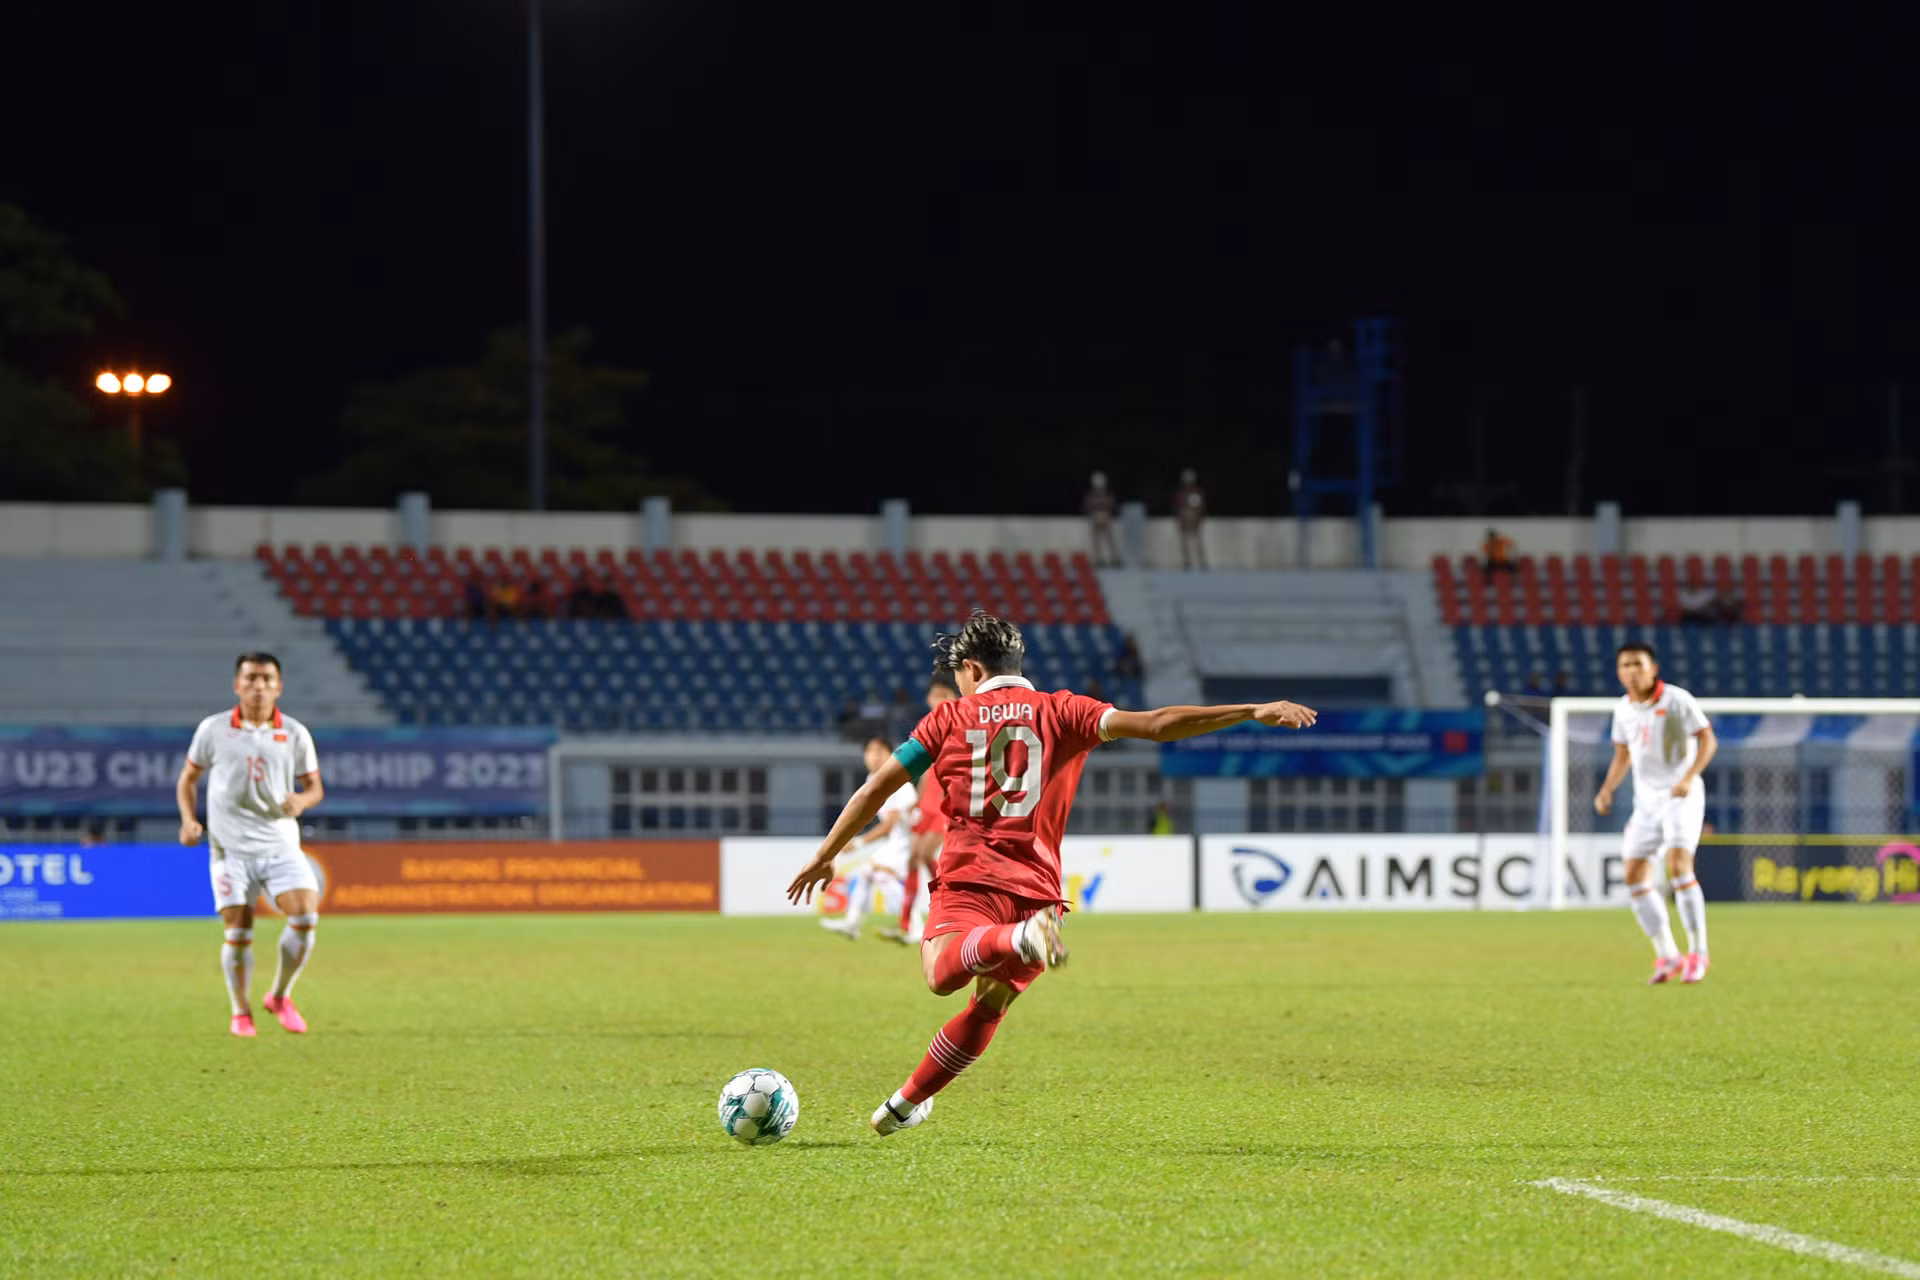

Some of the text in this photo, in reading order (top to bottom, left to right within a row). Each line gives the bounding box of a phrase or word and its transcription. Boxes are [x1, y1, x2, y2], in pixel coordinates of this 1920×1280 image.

[979, 703, 1033, 724] DEWA
[16, 751, 97, 788] U23
[247, 756, 266, 783] 15
[966, 726, 1042, 817] 19
[1753, 857, 1880, 902] Rayong
